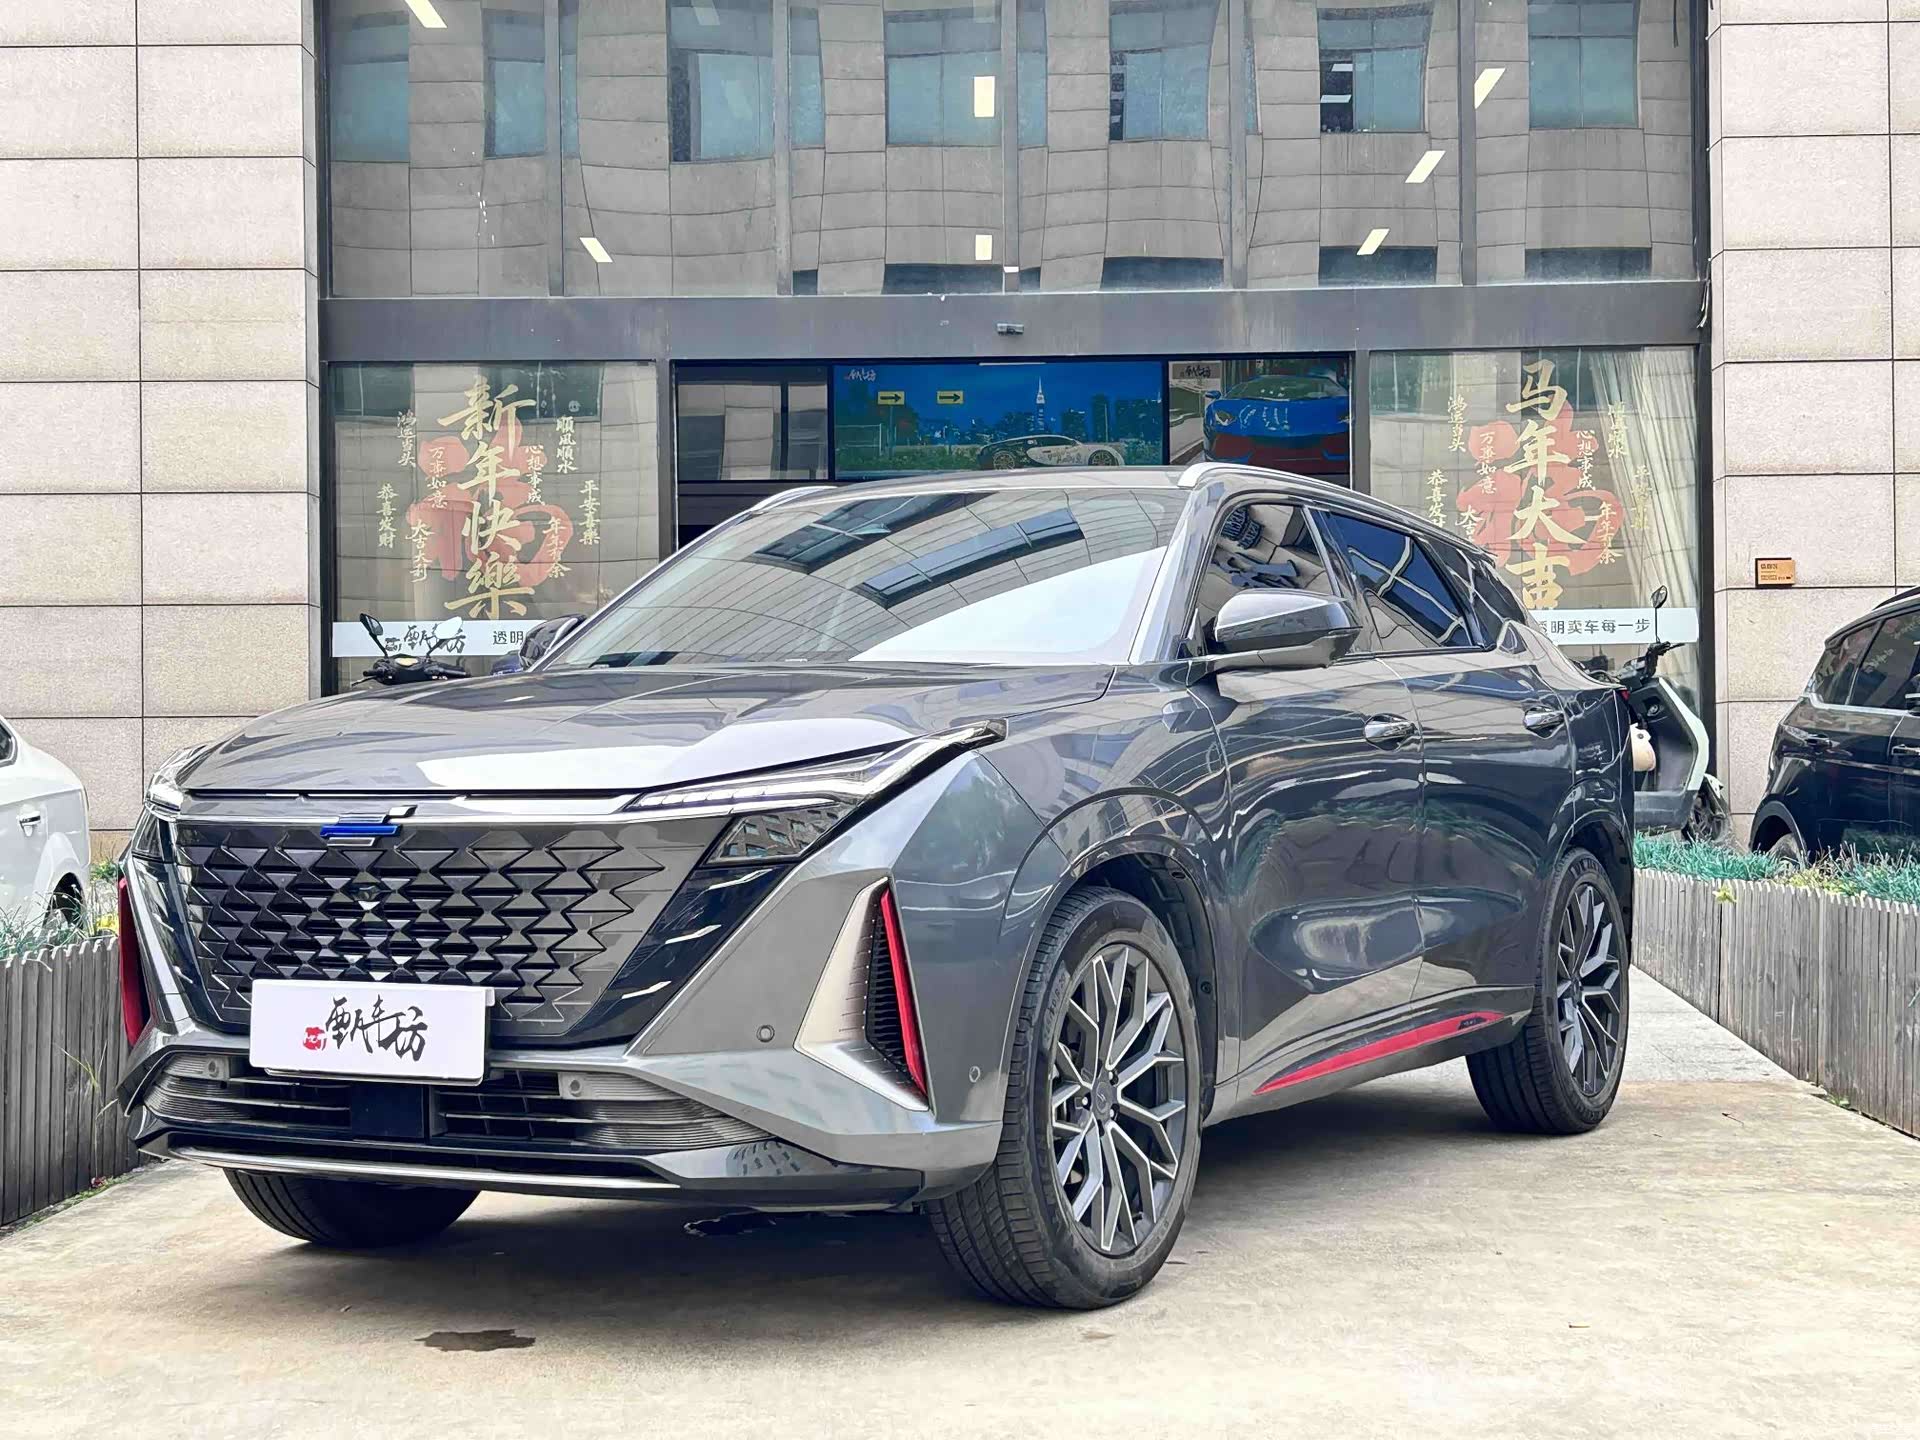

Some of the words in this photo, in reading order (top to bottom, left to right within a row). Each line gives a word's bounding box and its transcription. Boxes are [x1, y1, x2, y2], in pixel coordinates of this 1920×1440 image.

[525, 444, 546, 506] 心想事成
[1577, 430, 1596, 491] 心想事成
